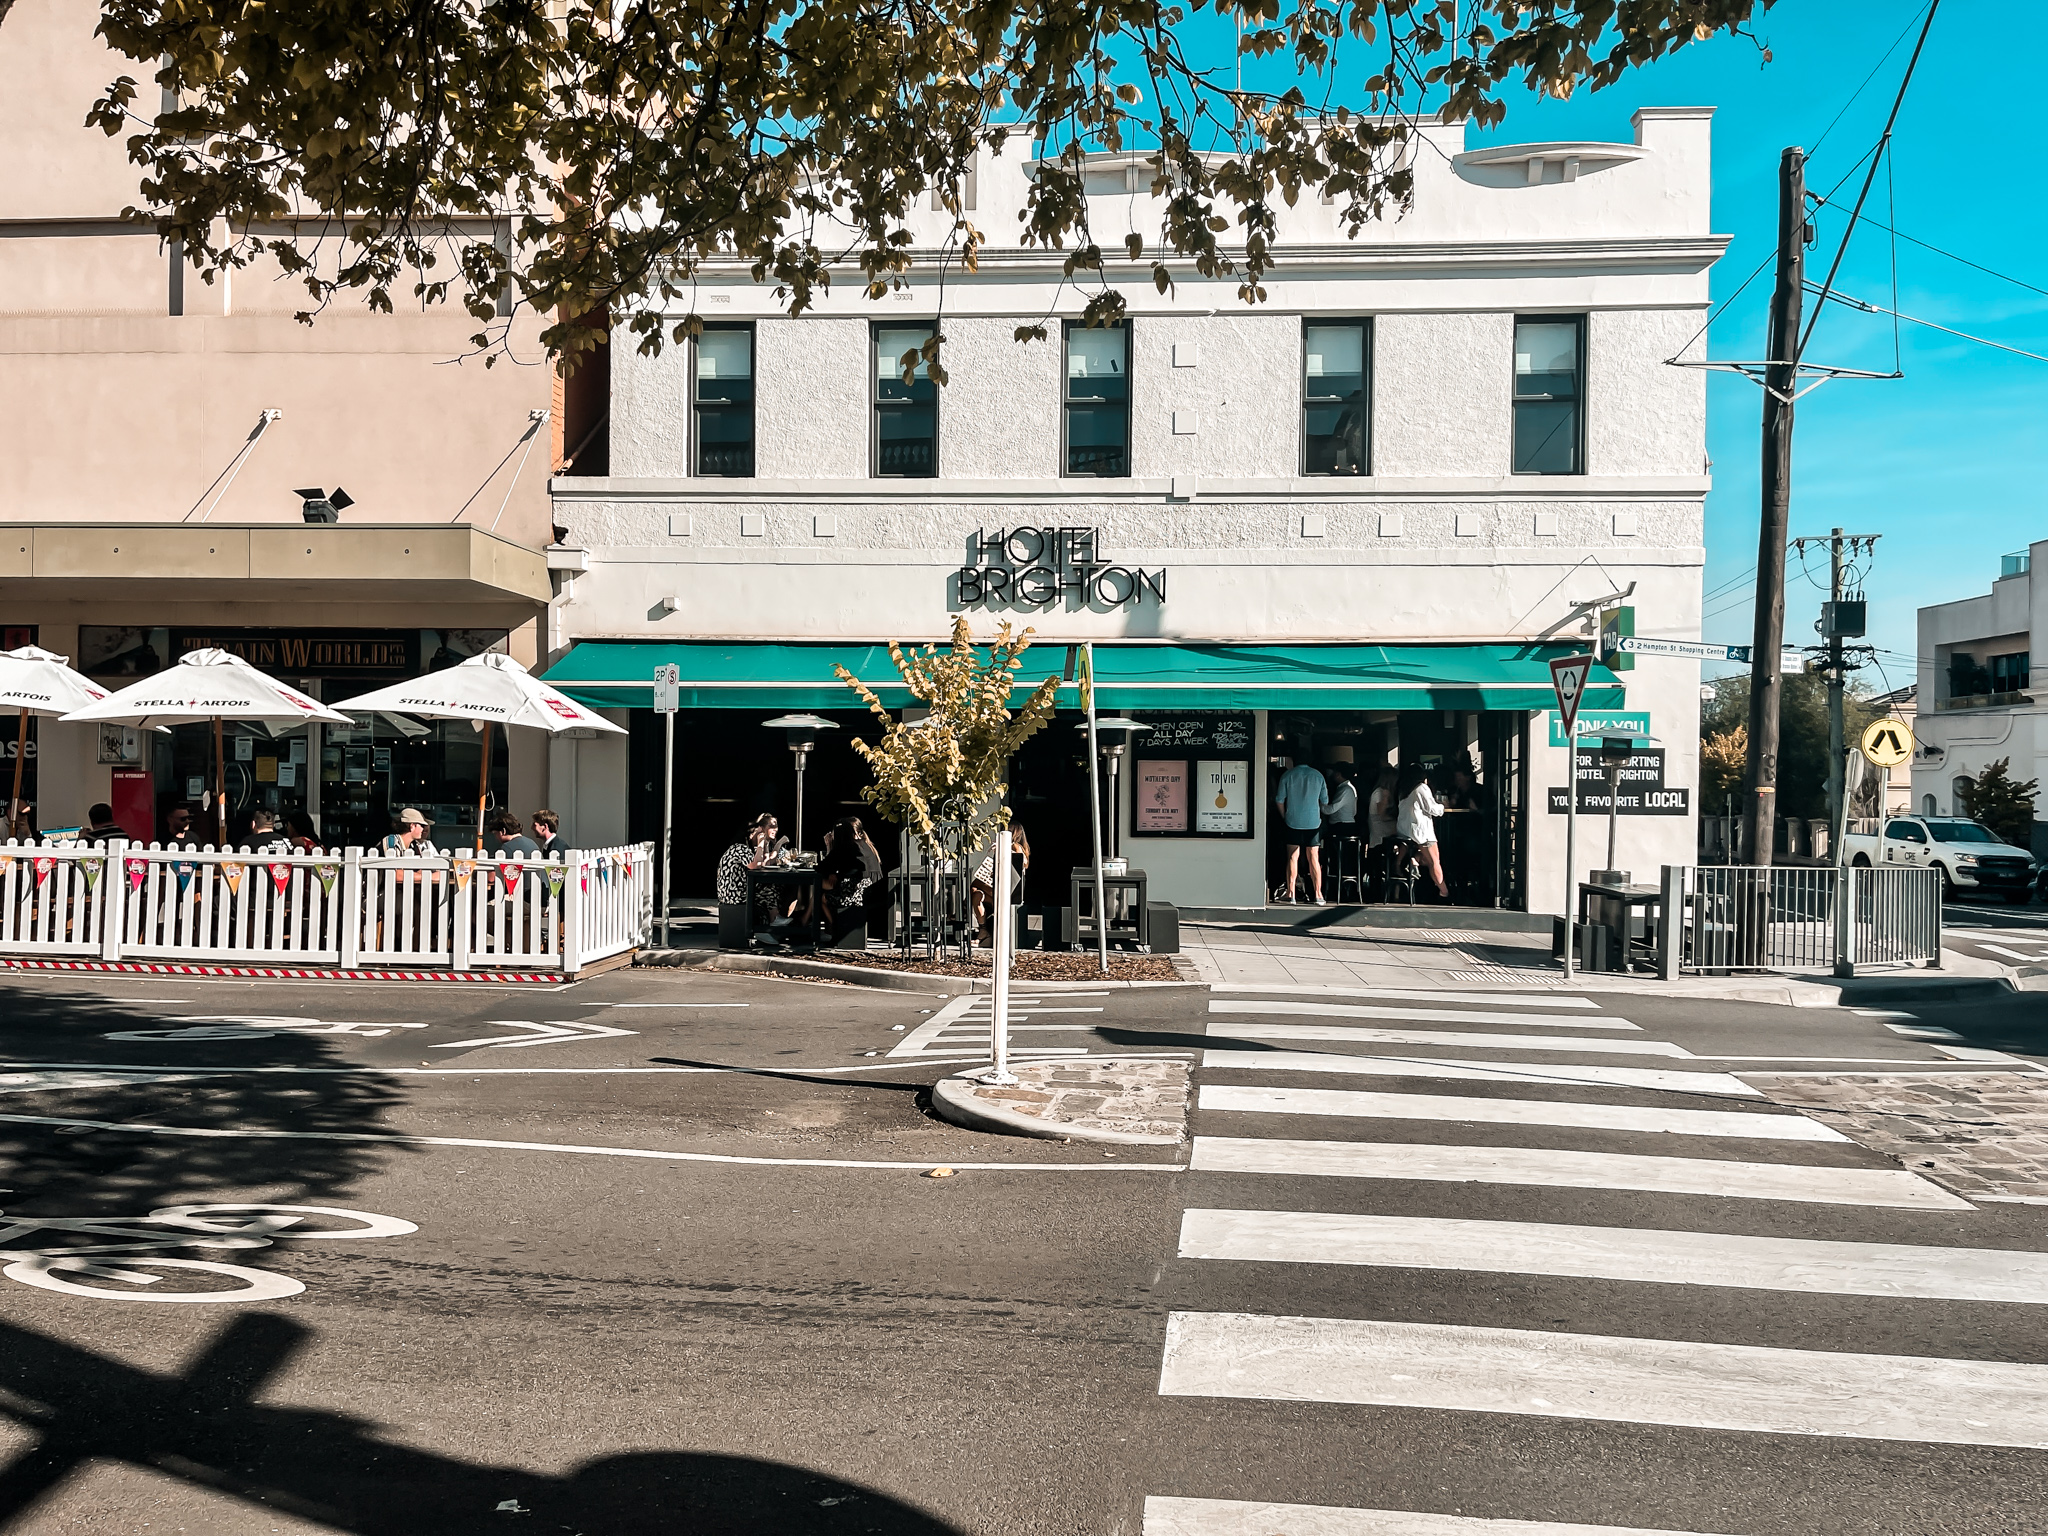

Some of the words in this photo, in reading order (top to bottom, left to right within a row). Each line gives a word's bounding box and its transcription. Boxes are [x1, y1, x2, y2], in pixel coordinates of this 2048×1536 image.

[980, 526, 1112, 563] HOTEL
[959, 567, 1166, 604] BRIGHTON
[1603, 631, 1617, 650] TAB
[1643, 642, 1668, 651] Hampton
[1670, 644, 1677, 652] St
[1679, 645, 1704, 655] Shopping
[1706, 647, 1726, 656] Centre
[655, 670, 666, 682] 2P
[1, 691, 52, 701] ARTOIS
[133, 699, 185, 707] STELLA
[398, 698, 446, 707] STELLA
[459, 703, 507, 714] ARTOIS
[1178, 721, 1204, 730] OPEN
[1554, 720, 1607, 739] TANK
[1153, 730, 1173, 738] ALL
[1175, 729, 1195, 738] DAY
[1138, 739, 1145, 747] 7
[1146, 738, 1171, 746] DAYS
[1173, 738, 1182, 746] A
[1183, 737, 1209, 745] WEEK
[1576, 756, 1592, 766] FOR
[1576, 769, 1605, 779] HOTEL
[1619, 770, 1659, 780] RIGHTON
[1585, 796, 1639, 807] FAVORITE
[1645, 792, 1686, 807] LOCAL
